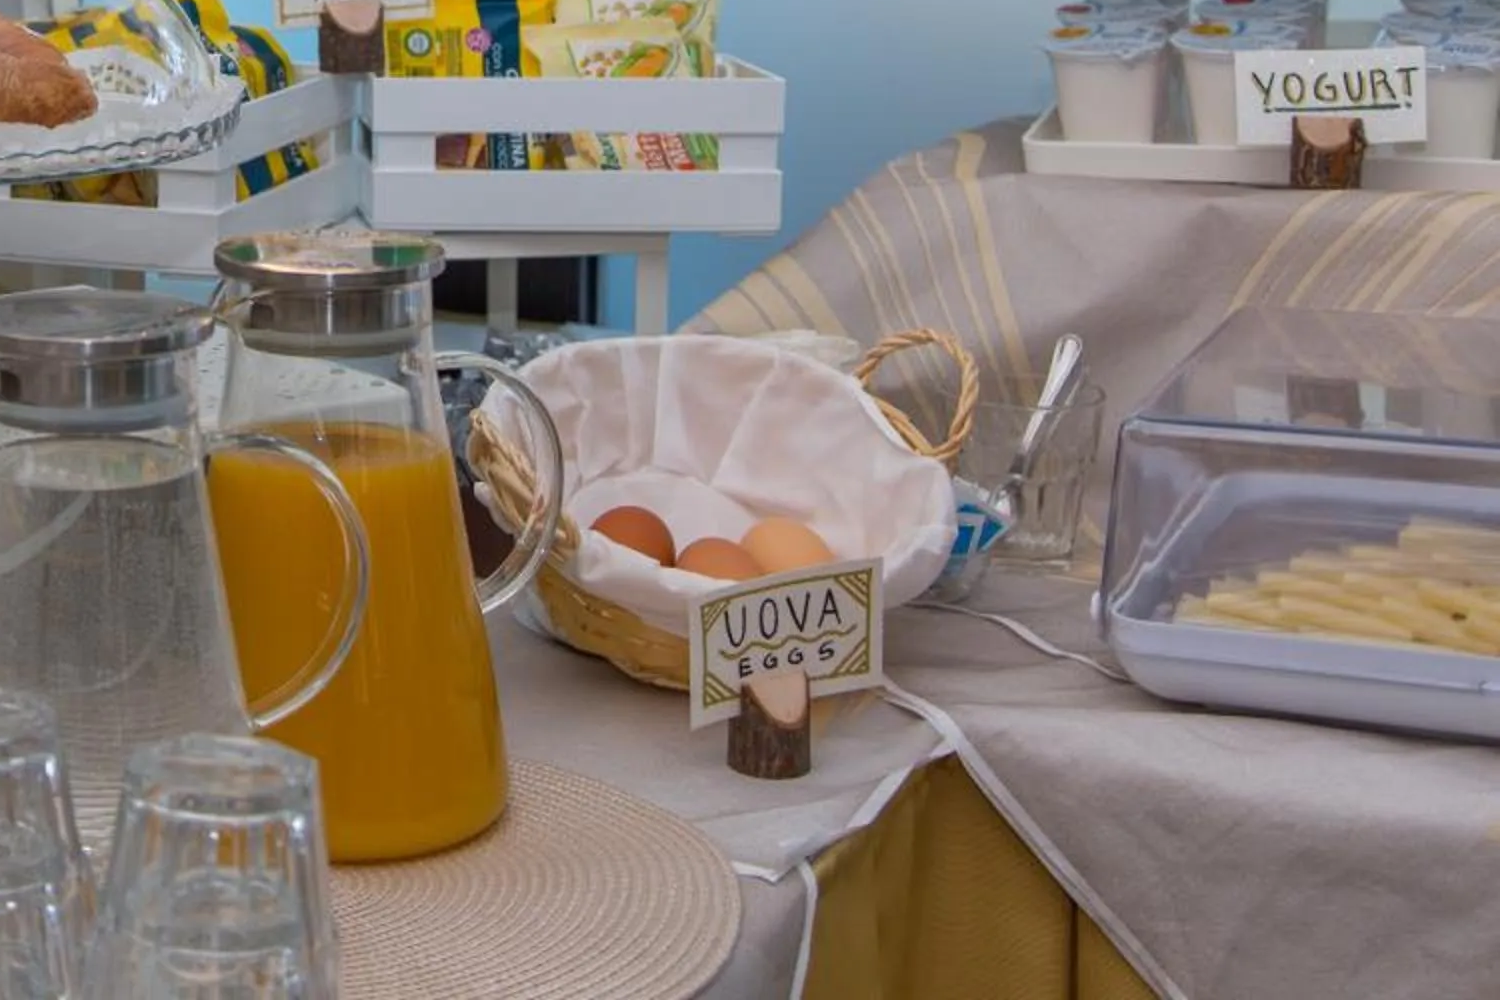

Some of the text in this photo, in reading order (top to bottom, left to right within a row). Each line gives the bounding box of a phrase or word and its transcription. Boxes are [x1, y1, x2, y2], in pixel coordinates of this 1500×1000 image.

[1251, 67, 1420, 103] YOGURT
[724, 587, 842, 648] UOVA
[738, 640, 836, 679] EGGS
